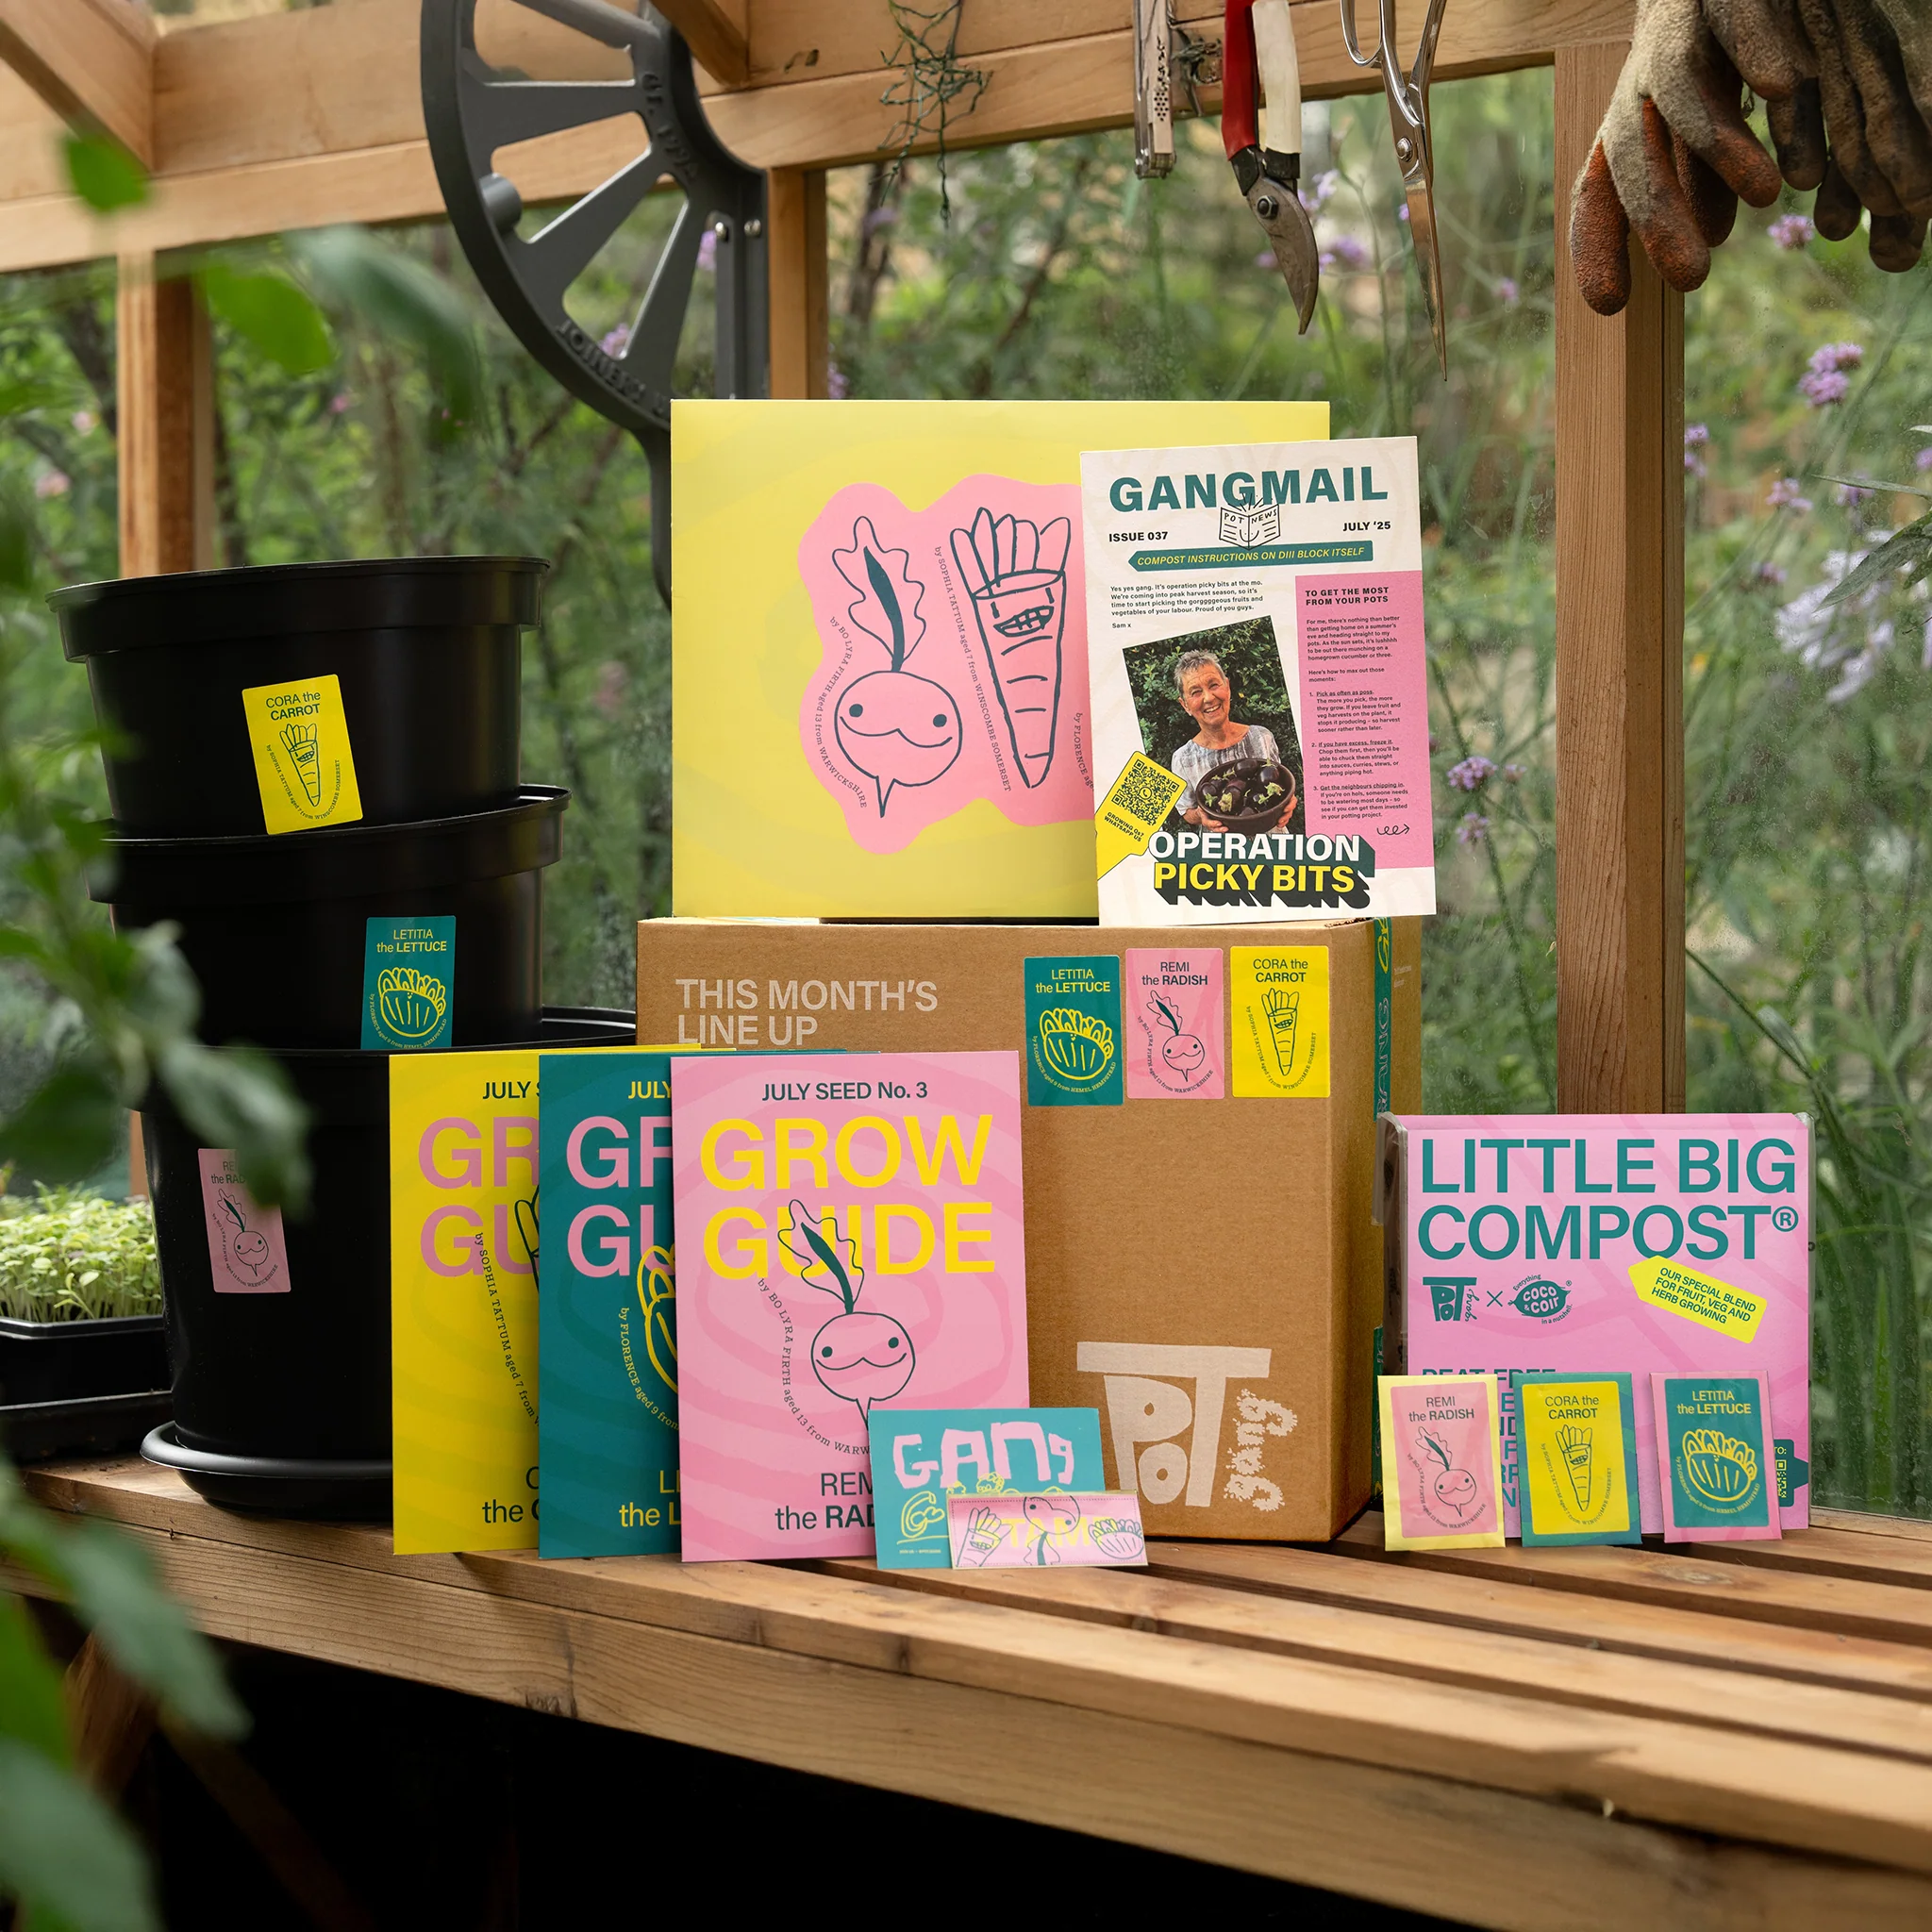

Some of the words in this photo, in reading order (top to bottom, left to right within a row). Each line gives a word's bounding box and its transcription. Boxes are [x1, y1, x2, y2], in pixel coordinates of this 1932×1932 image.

[1108, 466, 1389, 512] GANGMAIL
[1224, 512, 1244, 525] POT
[1251, 508, 1277, 525] NEWS
[1342, 522, 1371, 531] JULY
[1108, 532, 1144, 542] ISSUE
[1148, 531, 1169, 541] 037
[1137, 556, 1185, 566] COMPOST
[1188, 552, 1258, 563] INSTRUCTIONS
[1261, 551, 1276, 559] ON
[1297, 548, 1330, 558] BLOCK
[1331, 547, 1365, 557] ITSELF
[829, 617, 840, 628] by
[838, 626, 849, 639] BO
[844, 640, 853, 665] LYRA
[934, 546, 941, 558] by
[938, 558, 954, 593] SOPHIA
[949, 594, 965, 633] TATTUM
[959, 634, 972, 654] aged
[968, 661, 978, 683] from
[974, 683, 997, 741] WINSCOMBE
[991, 741, 1011, 791] SOMERSET
[826, 664, 845, 692] FIRTH
[265, 694, 301, 708] CORA
[302, 691, 321, 703] the
[816, 692, 828, 712] aged
[271, 703, 321, 721] CARROT
[815, 712, 823, 723] 13
[1074, 712, 1083, 724] by
[1074, 724, 1088, 775] FLORENCE
[819, 746, 868, 808] WARWICKSHIRE
[1084, 776, 1094, 791] age
[1104, 816, 1134, 836] WHATSAPP
[1107, 812, 1133, 830] GROWING
[1148, 832, 1359, 861] OPERATION
[1154, 862, 1266, 891] PICKY
[1272, 863, 1355, 892] BITS
[393, 929, 433, 940] LETITIA
[376, 942, 393, 953] the
[396, 941, 447, 952] LETTUCE
[1160, 961, 1190, 973] REMI
[1253, 958, 1288, 970] CORA
[1291, 958, 1308, 969] the
[1051, 969, 1094, 980] LETITIA
[1141, 975, 1159, 986] the
[1162, 974, 1208, 986] RADISH
[1256, 972, 1307, 983] CARROT
[675, 978, 758, 1009] THIS
[1035, 983, 1053, 993] the
[1056, 981, 1110, 993] LETTUCE
[677, 1014, 758, 1045] LINE
[768, 1016, 818, 1046] UP
[483, 1081, 531, 1099] JULY
[628, 1081, 672, 1099] JULY
[762, 1083, 811, 1102] JULY
[815, 1082, 873, 1101] SEED
[877, 1082, 910, 1100] No.
[916, 1081, 928, 1098] 3
[700, 1114, 993, 1191] GROW
[1422, 1139, 1656, 1193] LITTLE
[1679, 1138, 1796, 1193] BIG
[475, 1232, 484, 1246] by
[704, 1202, 995, 1280] GUIDE
[479, 1249, 497, 1297] SOPHIA
[758, 1277, 770, 1292] by
[1512, 1274, 1541, 1291] Everything
[1660, 1267, 1682, 1283] OUR
[1682, 1276, 1721, 1300] SPECIAL
[1724, 1293, 1757, 1312] BLEND
[769, 1292, 783, 1309] BO
[1651, 1287, 1679, 1305] HERB
[1679, 1299, 1727, 1324] GROWING
[1656, 1277, 1677, 1291] FOR
[1676, 1286, 1707, 1306] FRUIT,
[1708, 1298, 1727, 1313] VEG
[1728, 1307, 1751, 1323] AND
[619, 1307, 629, 1321] by
[492, 1299, 511, 1351] TATTUM
[778, 1309, 793, 1343] LYRA
[620, 1323, 640, 1386] FLORENCE
[506, 1354, 521, 1380] aged
[782, 1347, 791, 1386] FIRTH
[519, 1390, 534, 1417] from
[635, 1386, 654, 1408] aged
[783, 1389, 800, 1414] aged
[1426, 1396, 1456, 1407] REMI
[1545, 1396, 1579, 1407] CORA
[1581, 1395, 1599, 1406] the
[1692, 1391, 1735, 1401] LETITIA
[651, 1407, 659, 1415] 9
[1408, 1411, 1426, 1423] the
[1429, 1408, 1474, 1421] RADISH
[1548, 1408, 1598, 1420] CARROT
[1676, 1404, 1694, 1415] the
[1697, 1404, 1752, 1414] LETTUCE
[796, 1414, 808, 1426] 13
[807, 1424, 831, 1446] from
[821, 1472, 874, 1496] REM
[482, 1499, 524, 1524] the
[619, 1502, 660, 1527] the
[774, 1505, 817, 1530] the
